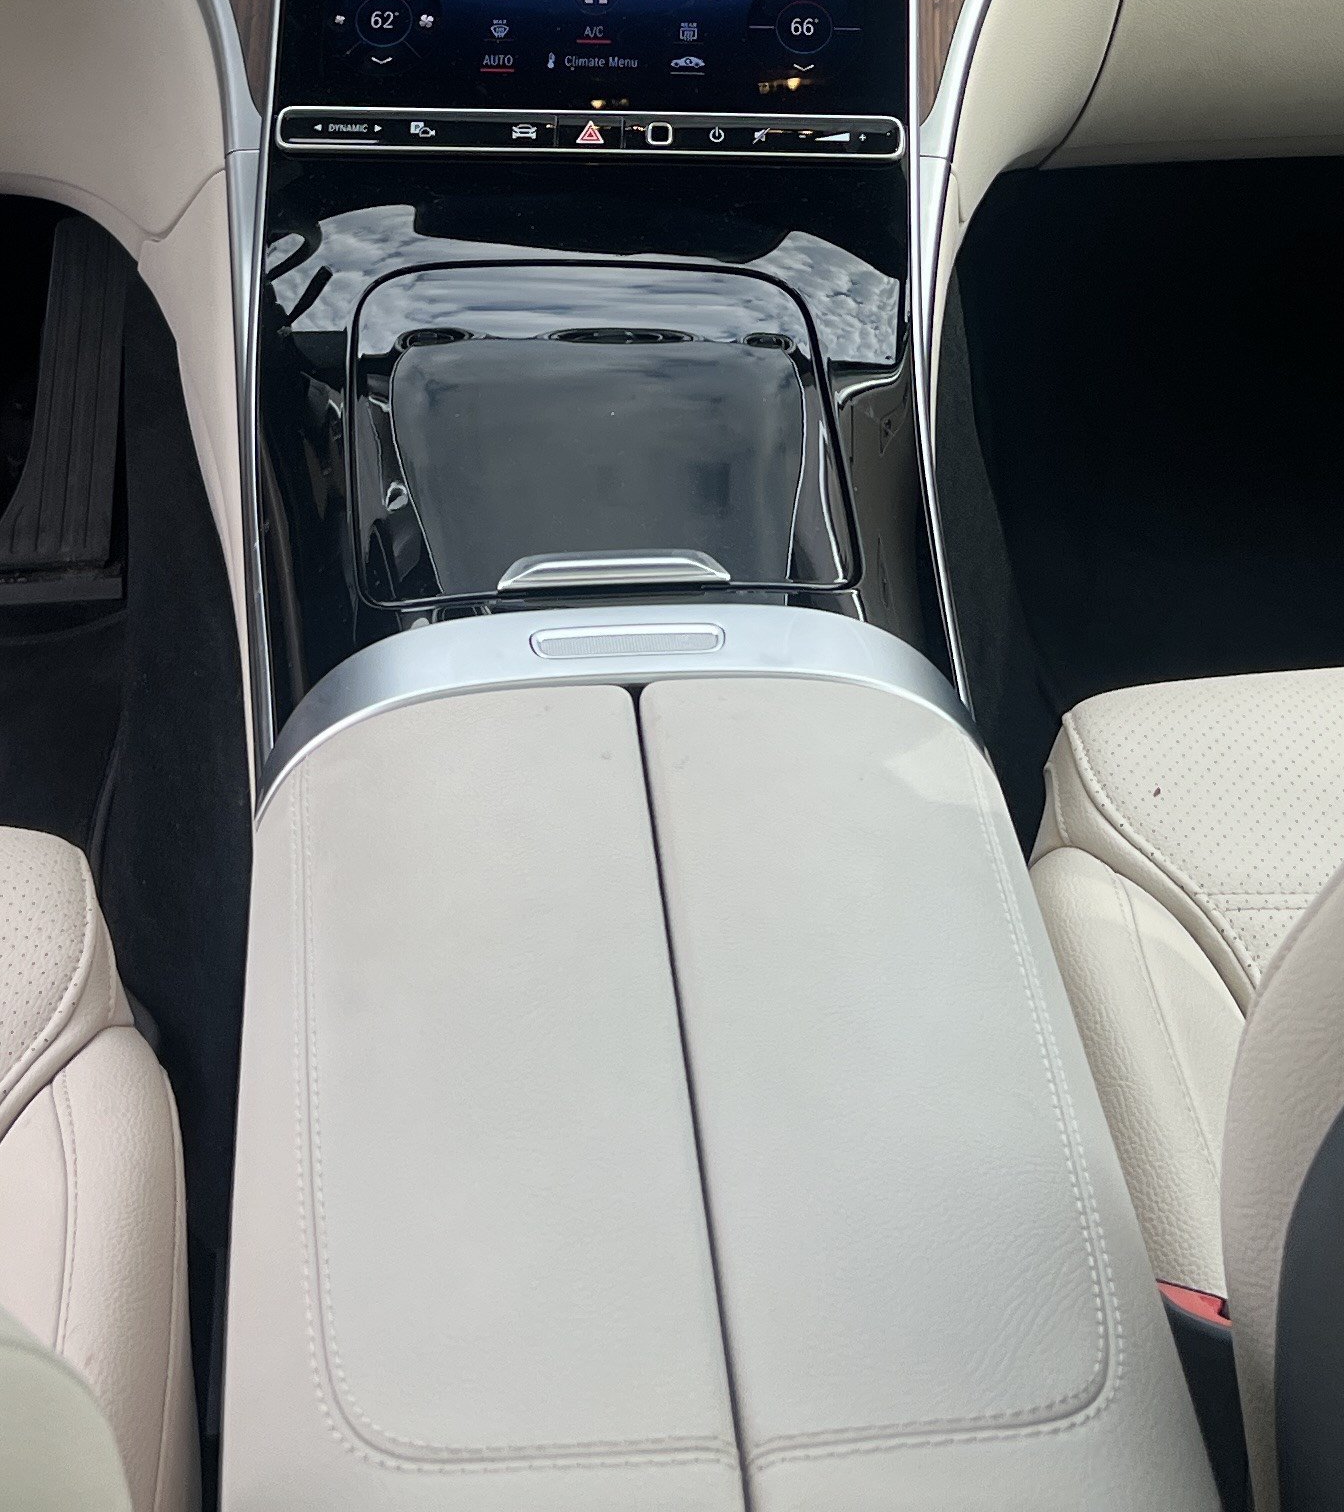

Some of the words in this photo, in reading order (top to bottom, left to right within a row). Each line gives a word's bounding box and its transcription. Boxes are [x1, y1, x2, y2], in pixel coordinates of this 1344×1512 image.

[583, 26, 604, 38] A/C
[482, 54, 514, 67] AUTO
[564, 55, 606, 68] Climate
[608, 56, 639, 69] Menu
[327, 123, 369, 133] DYNAMIC
